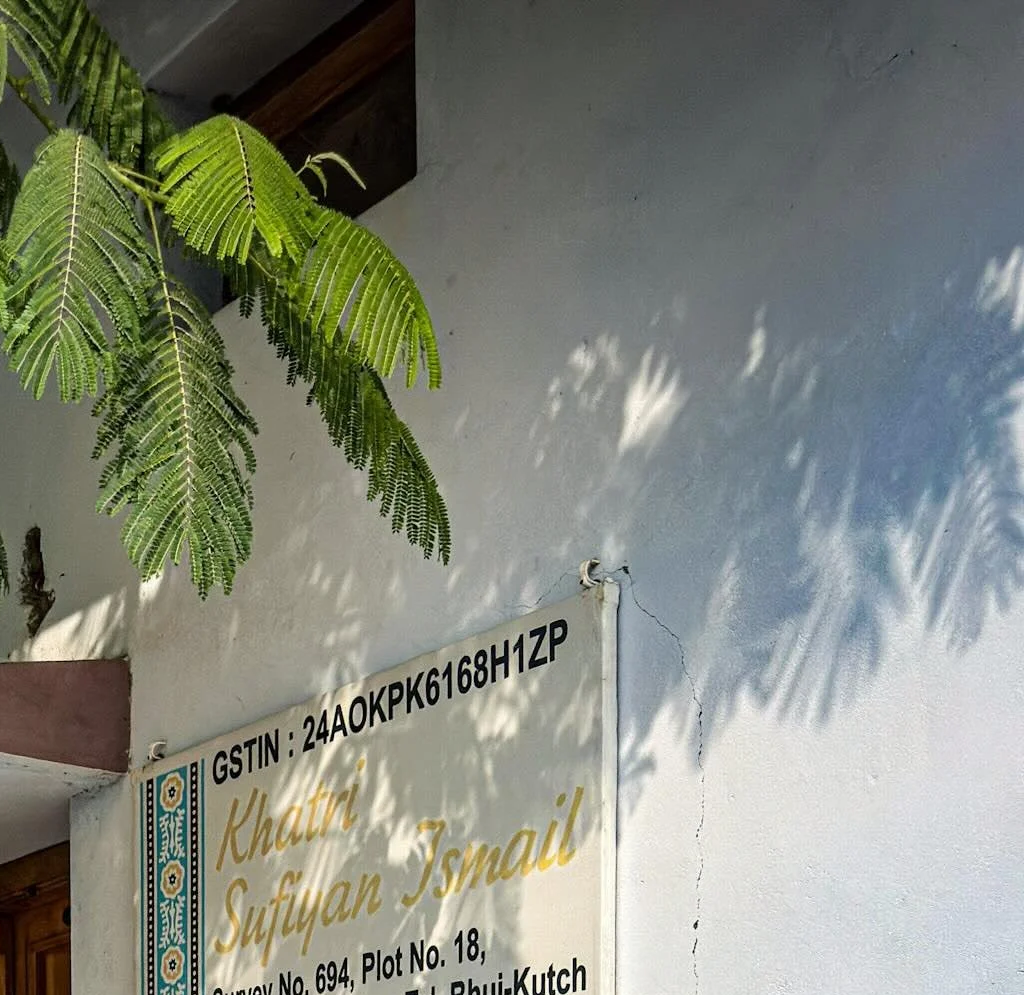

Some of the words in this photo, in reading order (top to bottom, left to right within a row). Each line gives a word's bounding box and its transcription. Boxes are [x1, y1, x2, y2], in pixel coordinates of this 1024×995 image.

[212, 728, 280, 785] GSTIN
[302, 618, 568, 754] 24AOKPK6168H1ZP
[214, 871, 382, 967] Sufiyan
[402, 786, 584, 910] Ismail
[217, 757, 366, 871] Khatri
[315, 962, 355, 994] 694,
[362, 950, 402, 984] Plot
[410, 945, 446, 977] No.
[453, 928, 486, 966] 18,
